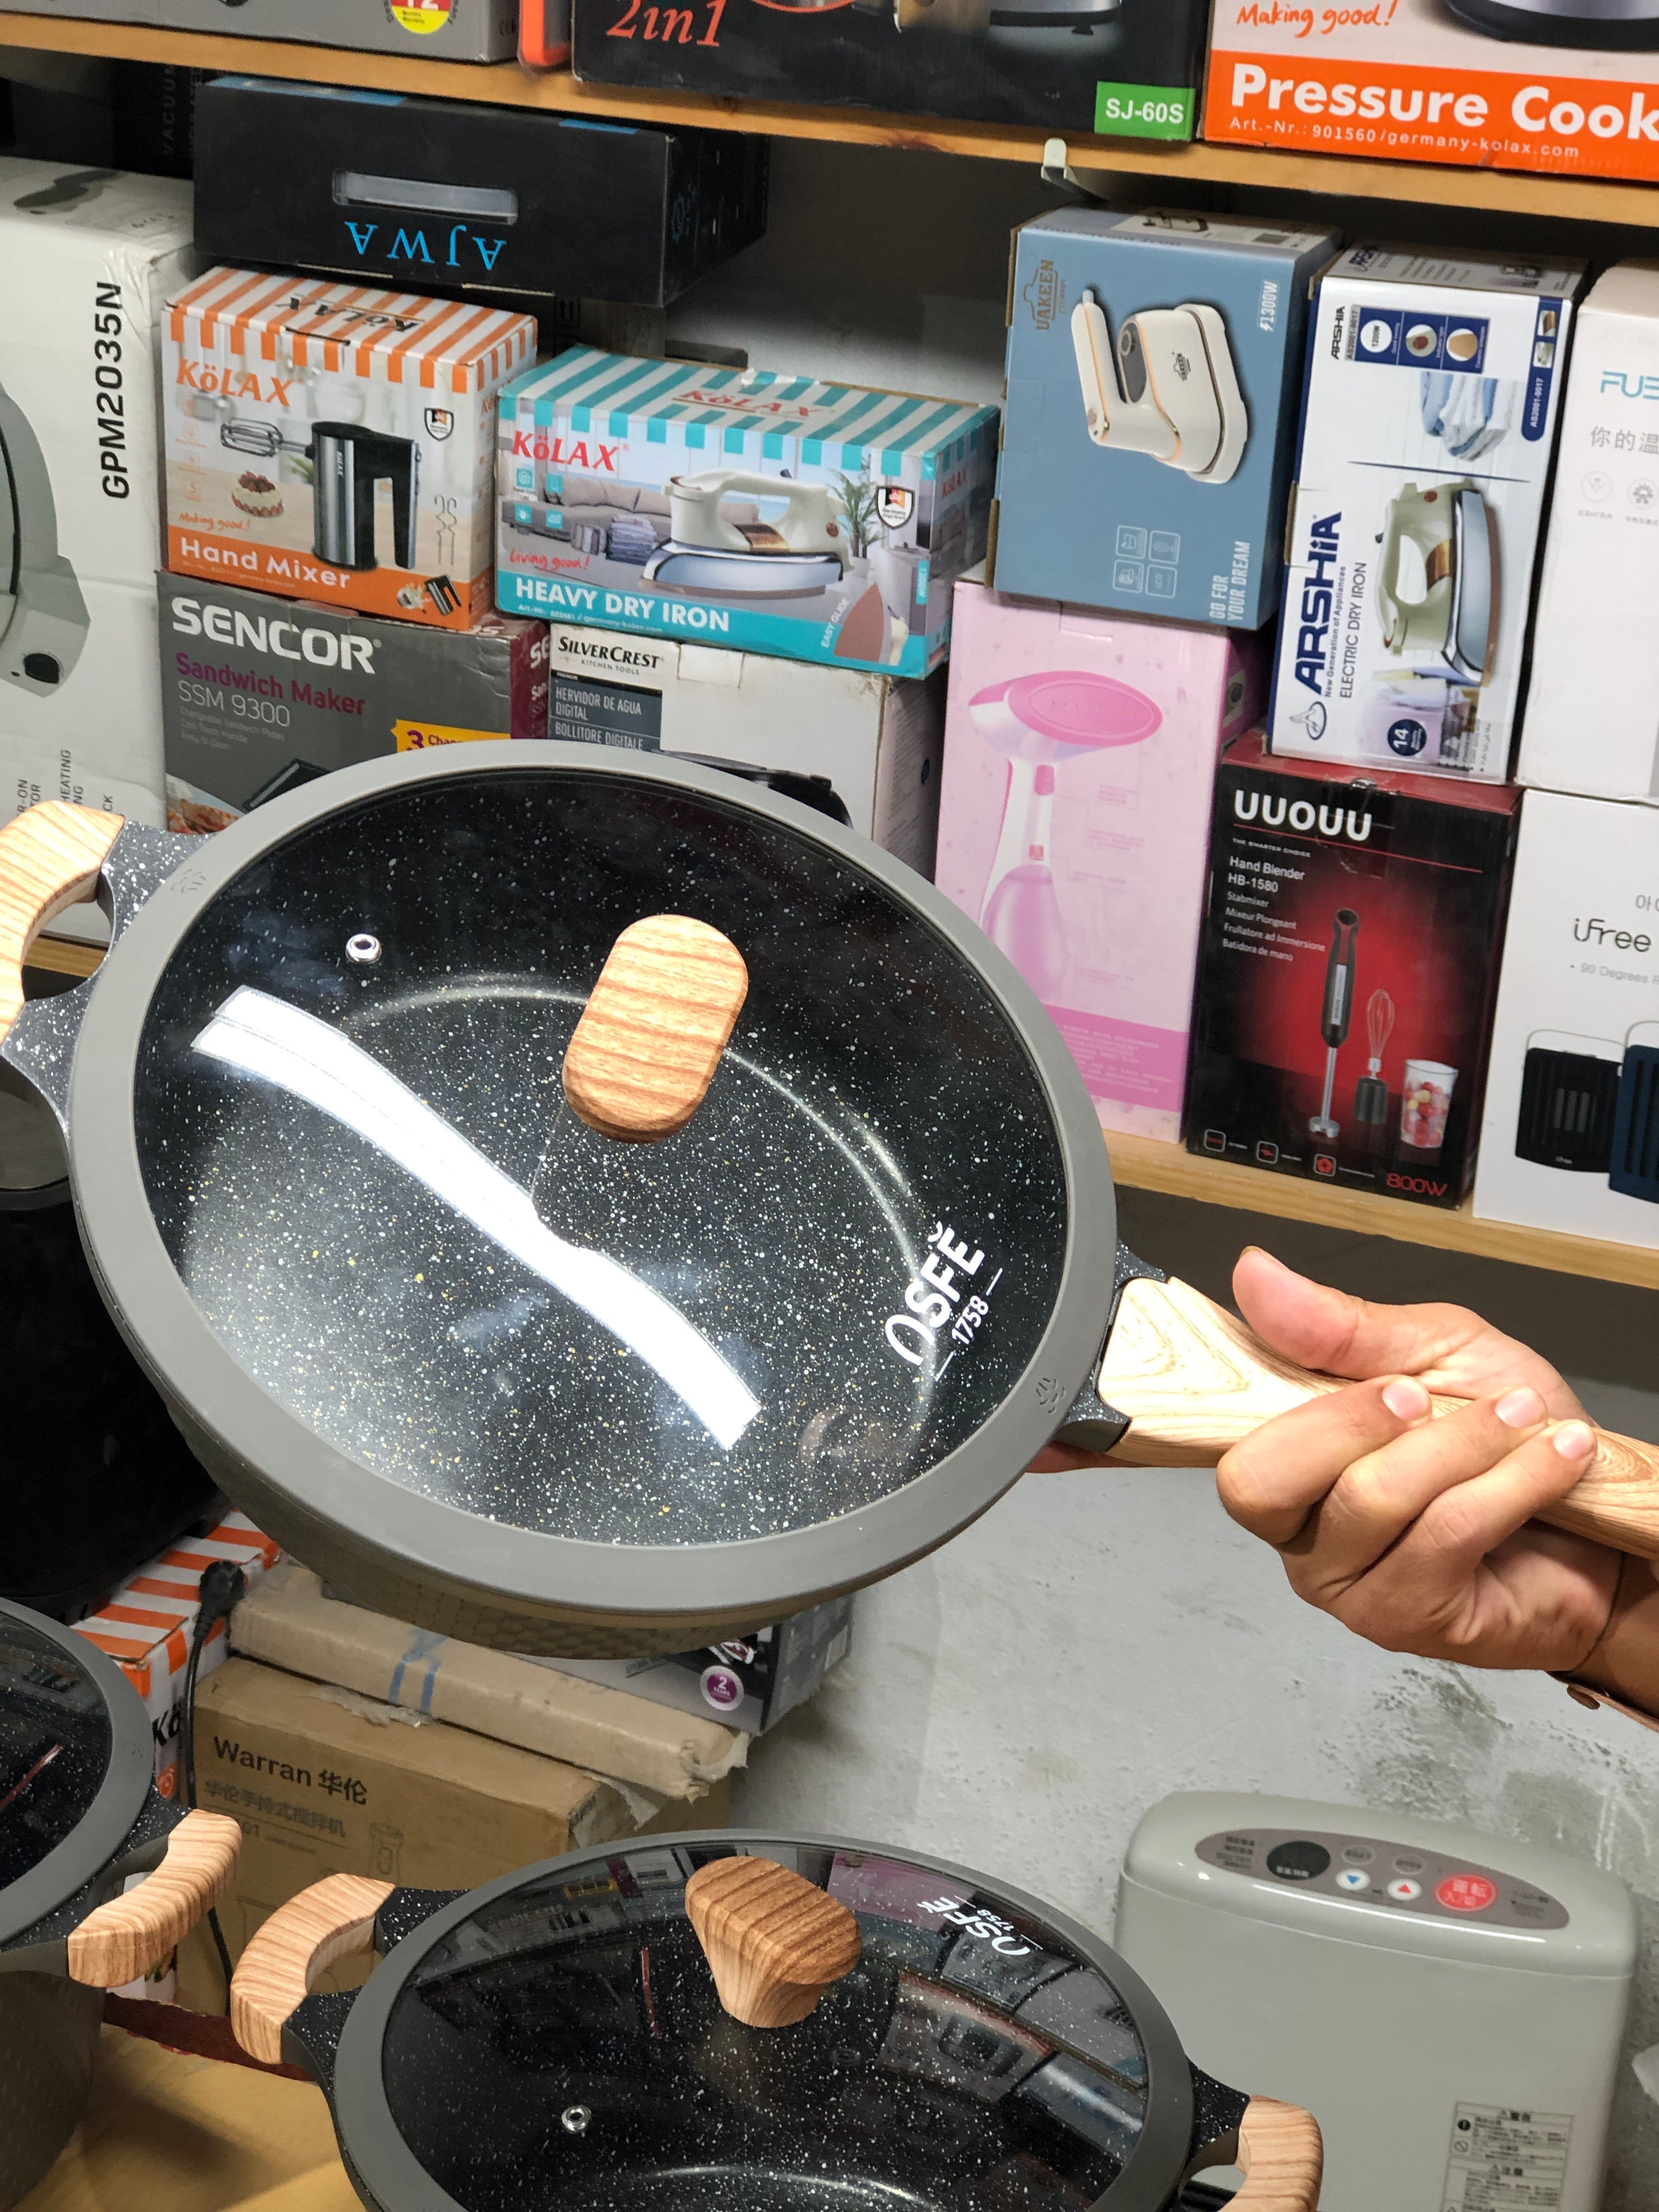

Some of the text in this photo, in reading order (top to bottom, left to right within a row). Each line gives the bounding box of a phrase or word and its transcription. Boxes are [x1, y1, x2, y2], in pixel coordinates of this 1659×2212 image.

[1237, 0, 1398, 38] Making good!
[1105, 97, 1184, 125] SJ-60S
[1231, 63, 1659, 143] Pressure Cook
[345, 221, 507, 270] AJWA
[95, 281, 130, 499] GPM2035N
[176, 358, 293, 408] KöLAX
[511, 430, 619, 472] KöLAX
[180, 537, 258, 571] Hand
[267, 555, 350, 589] Mixer
[1227, 540, 1251, 621] YOUR DREAM
[516, 577, 730, 633] HEAVY DRY IRON
[1209, 574, 1229, 620] GO FOR
[172, 597, 376, 675] SENCOR
[1324, 566, 1347, 697] New Generation of Appliances
[1340, 562, 1368, 699] ELECTRIC DRY IRON
[176, 652, 366, 716] Sandwich Maker
[581, 659, 640, 675] KITCHEN TOOLS
[178, 680, 225, 712] SSM
[231, 693, 290, 727] 9300
[555, 687, 601, 708] HERVIDOR
[603, 696, 616, 710] DE
[617, 699, 642, 715] AGUA
[555, 701, 588, 721] DIGITAL
[555, 721, 644, 751] BOLLITORE DIGITALE
[1393, 727, 1409, 748] 14
[1234, 789, 1372, 842] UUOUU
[1228, 872, 1279, 893] HB-1580
[1229, 855, 1306, 881] Hand Blender
[1580, 962, 1596, 974] 90
[1599, 965, 1649, 984] Degrees
[951, 1295, 989, 1345] 1758
[213, 1736, 312, 1787] Warran
